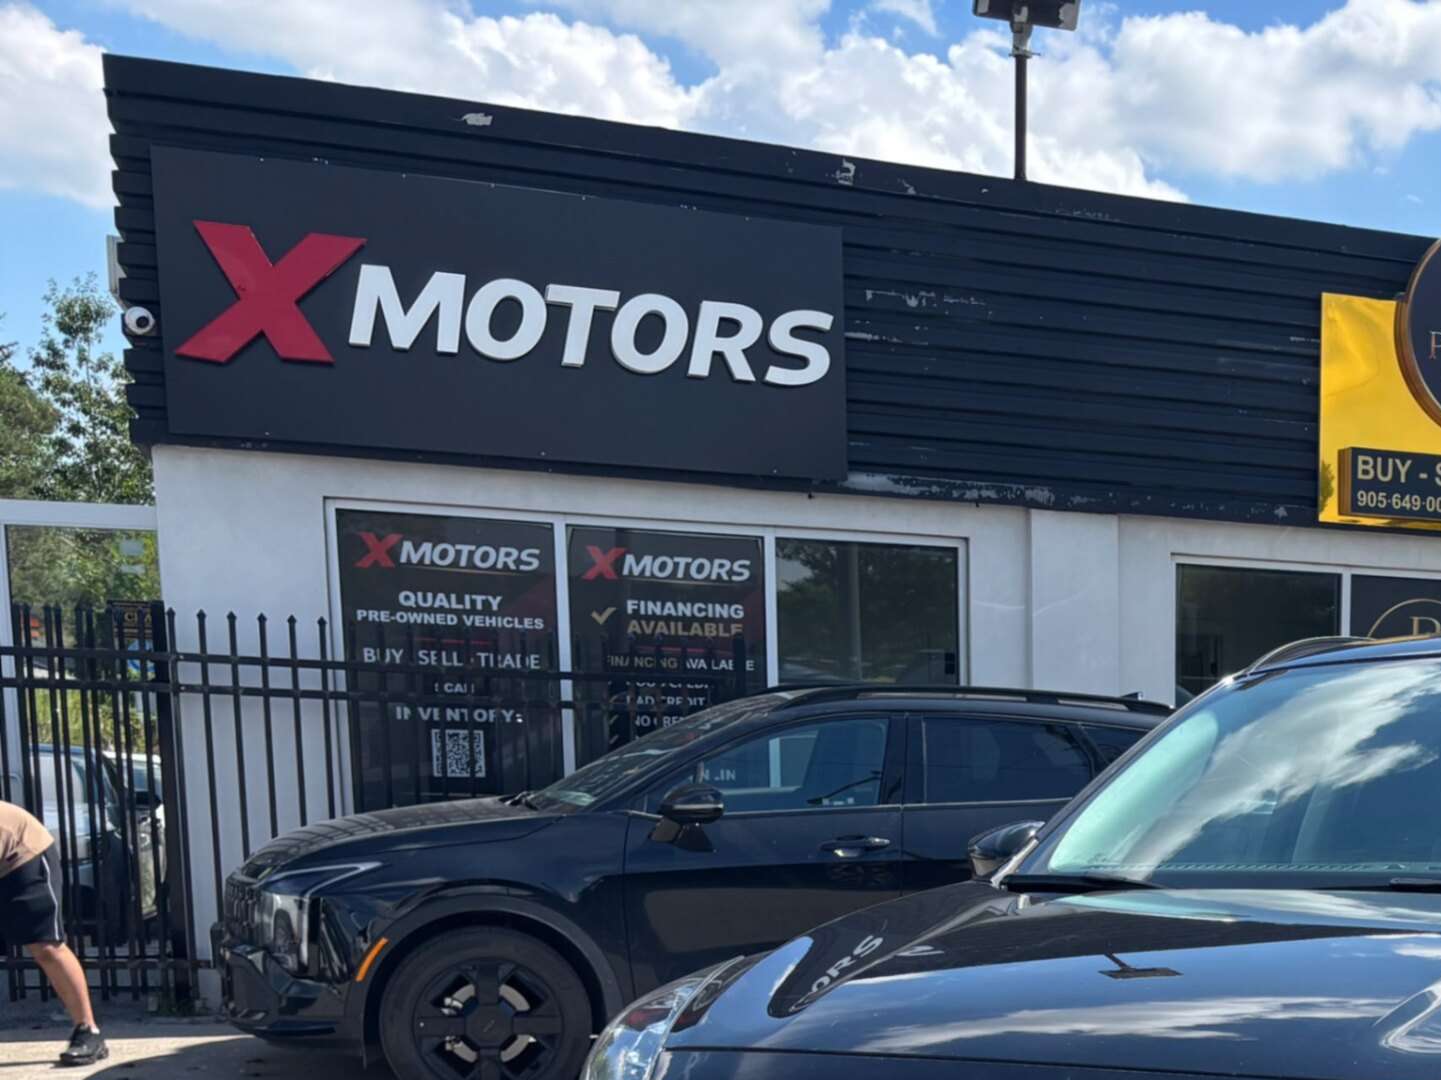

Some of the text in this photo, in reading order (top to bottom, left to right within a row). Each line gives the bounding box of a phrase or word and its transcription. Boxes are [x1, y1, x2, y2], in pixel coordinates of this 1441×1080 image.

[176, 219, 834, 386] X MOTORS
[1357, 455, 1412, 483] BUY
[353, 532, 540, 571] X MOTORS
[582, 545, 751, 582] X MOTORS
[399, 590, 502, 611] QUALITY
[626, 600, 744, 619] FINANCING
[356, 609, 544, 629] PRE-OWNED VEHICLES
[627, 620, 743, 637] AVAILABLE
[418, 650, 463, 666] SELL
